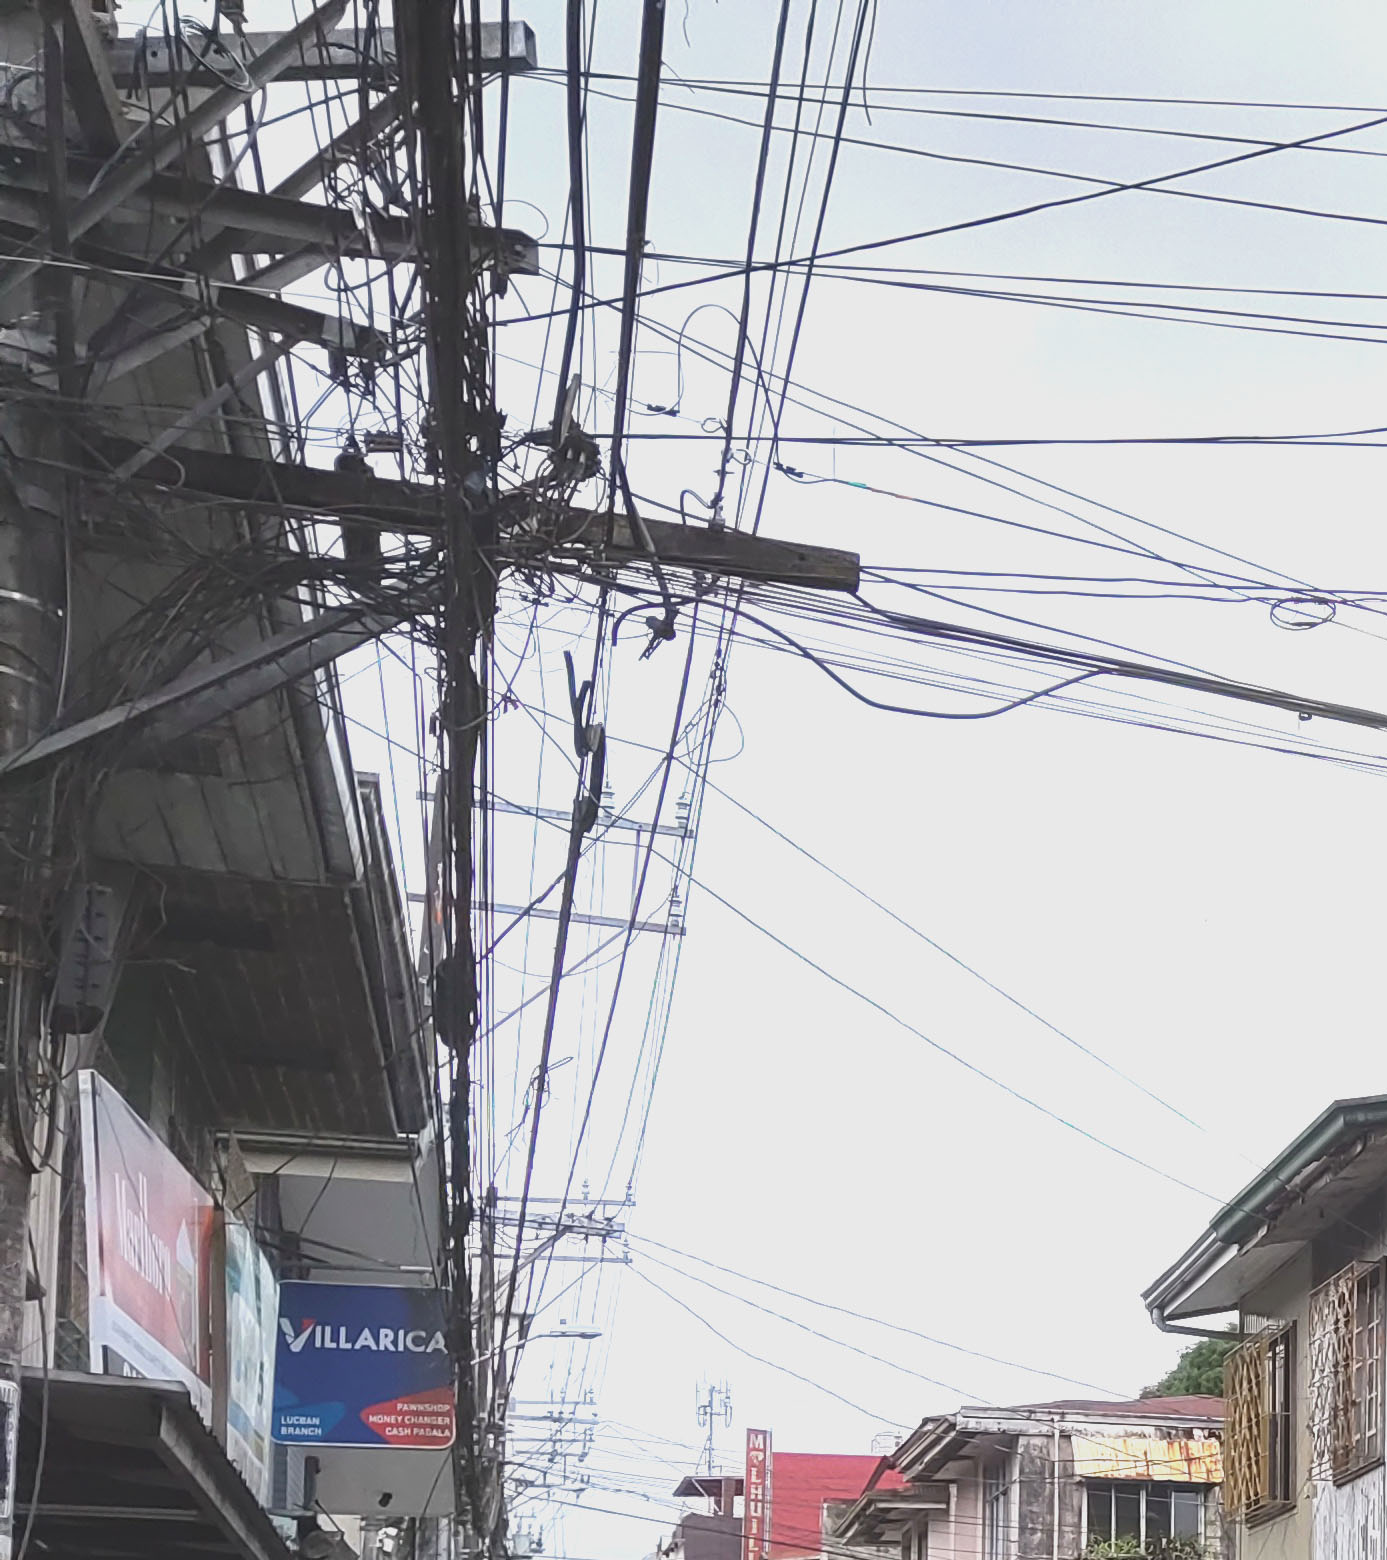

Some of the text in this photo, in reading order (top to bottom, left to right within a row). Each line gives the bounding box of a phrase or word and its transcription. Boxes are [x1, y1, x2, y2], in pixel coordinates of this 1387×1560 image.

[279, 1317, 448, 1354] VILLARICA
[397, 1403, 450, 1412] PAWNSHOP
[369, 1415, 450, 1425] MONEY CHANGER
[280, 1427, 322, 1436] BRANCH
[385, 1427, 411, 1436] CASH
